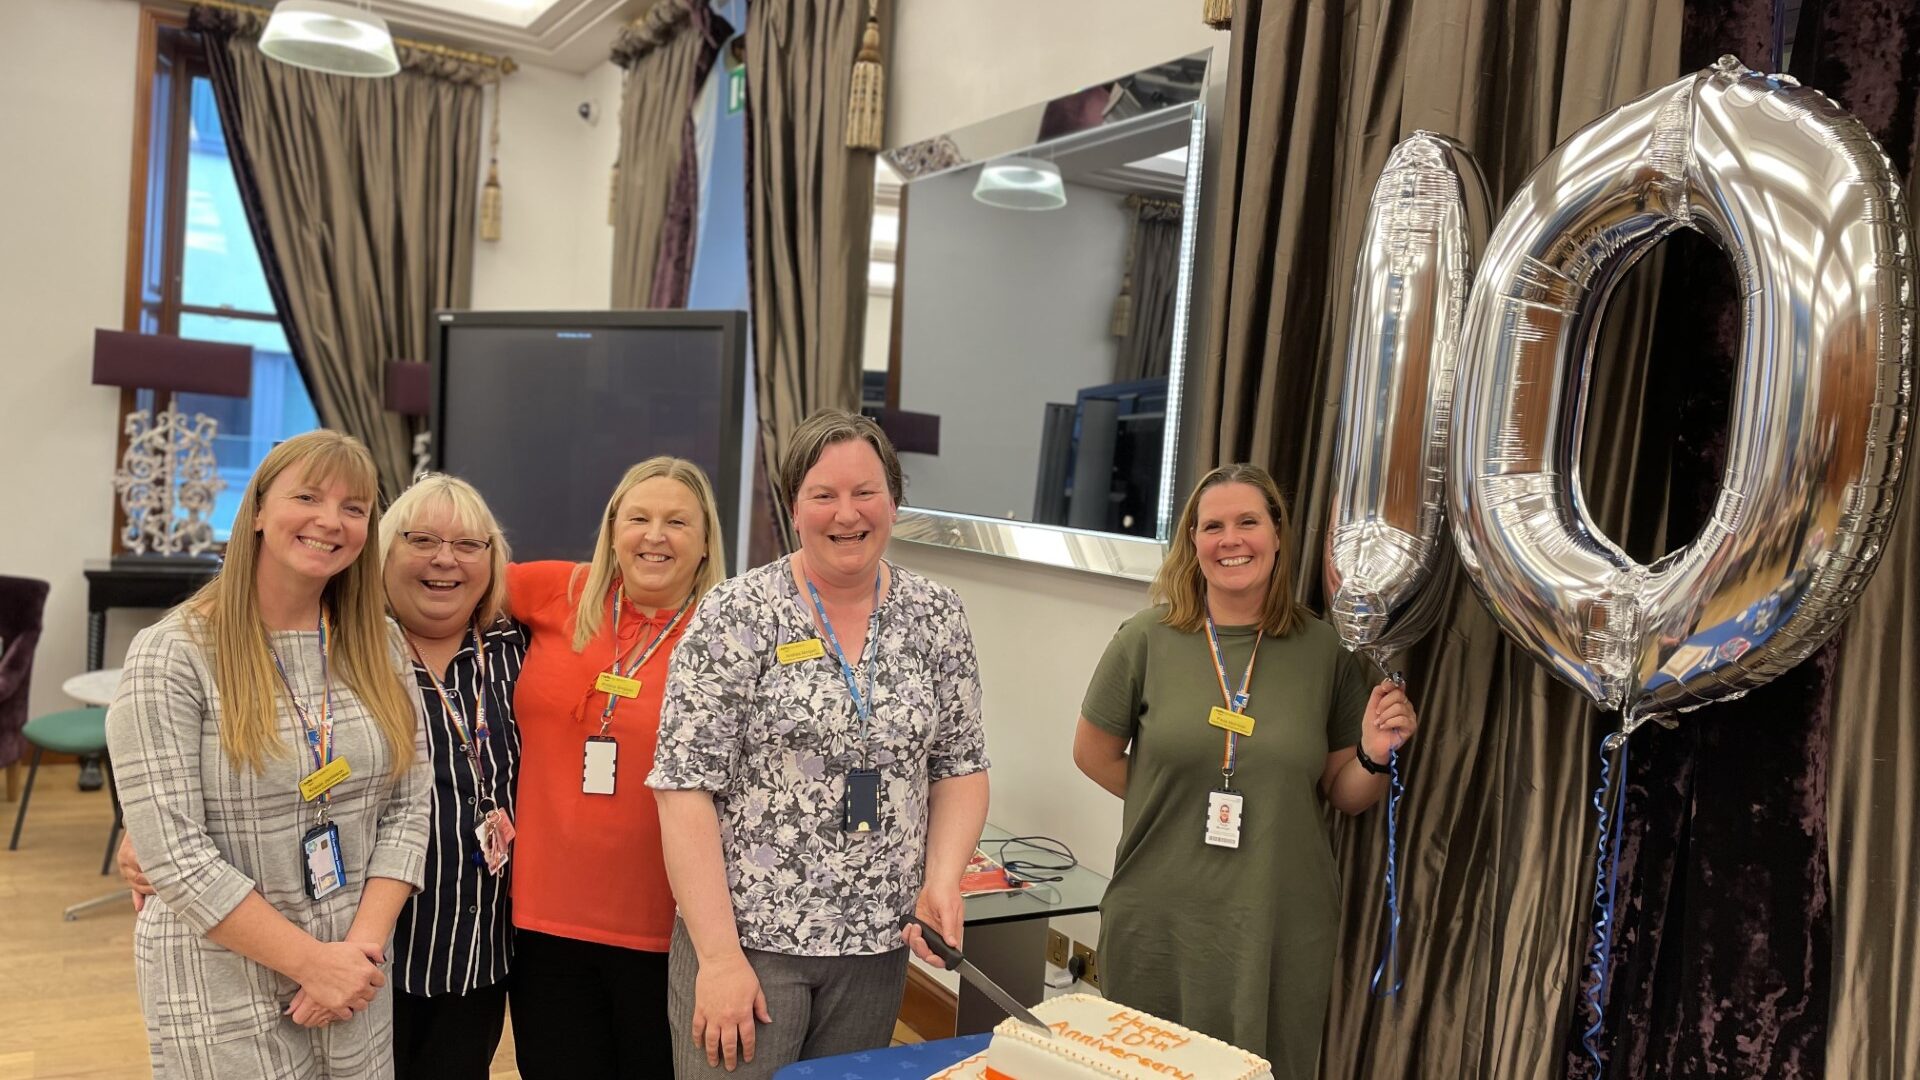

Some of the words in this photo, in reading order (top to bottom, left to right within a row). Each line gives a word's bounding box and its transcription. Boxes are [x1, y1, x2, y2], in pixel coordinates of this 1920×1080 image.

[453, 711, 465, 727] NHS
[478, 707, 486, 724] NHS
[1107, 1011, 1191, 1049] Happy
